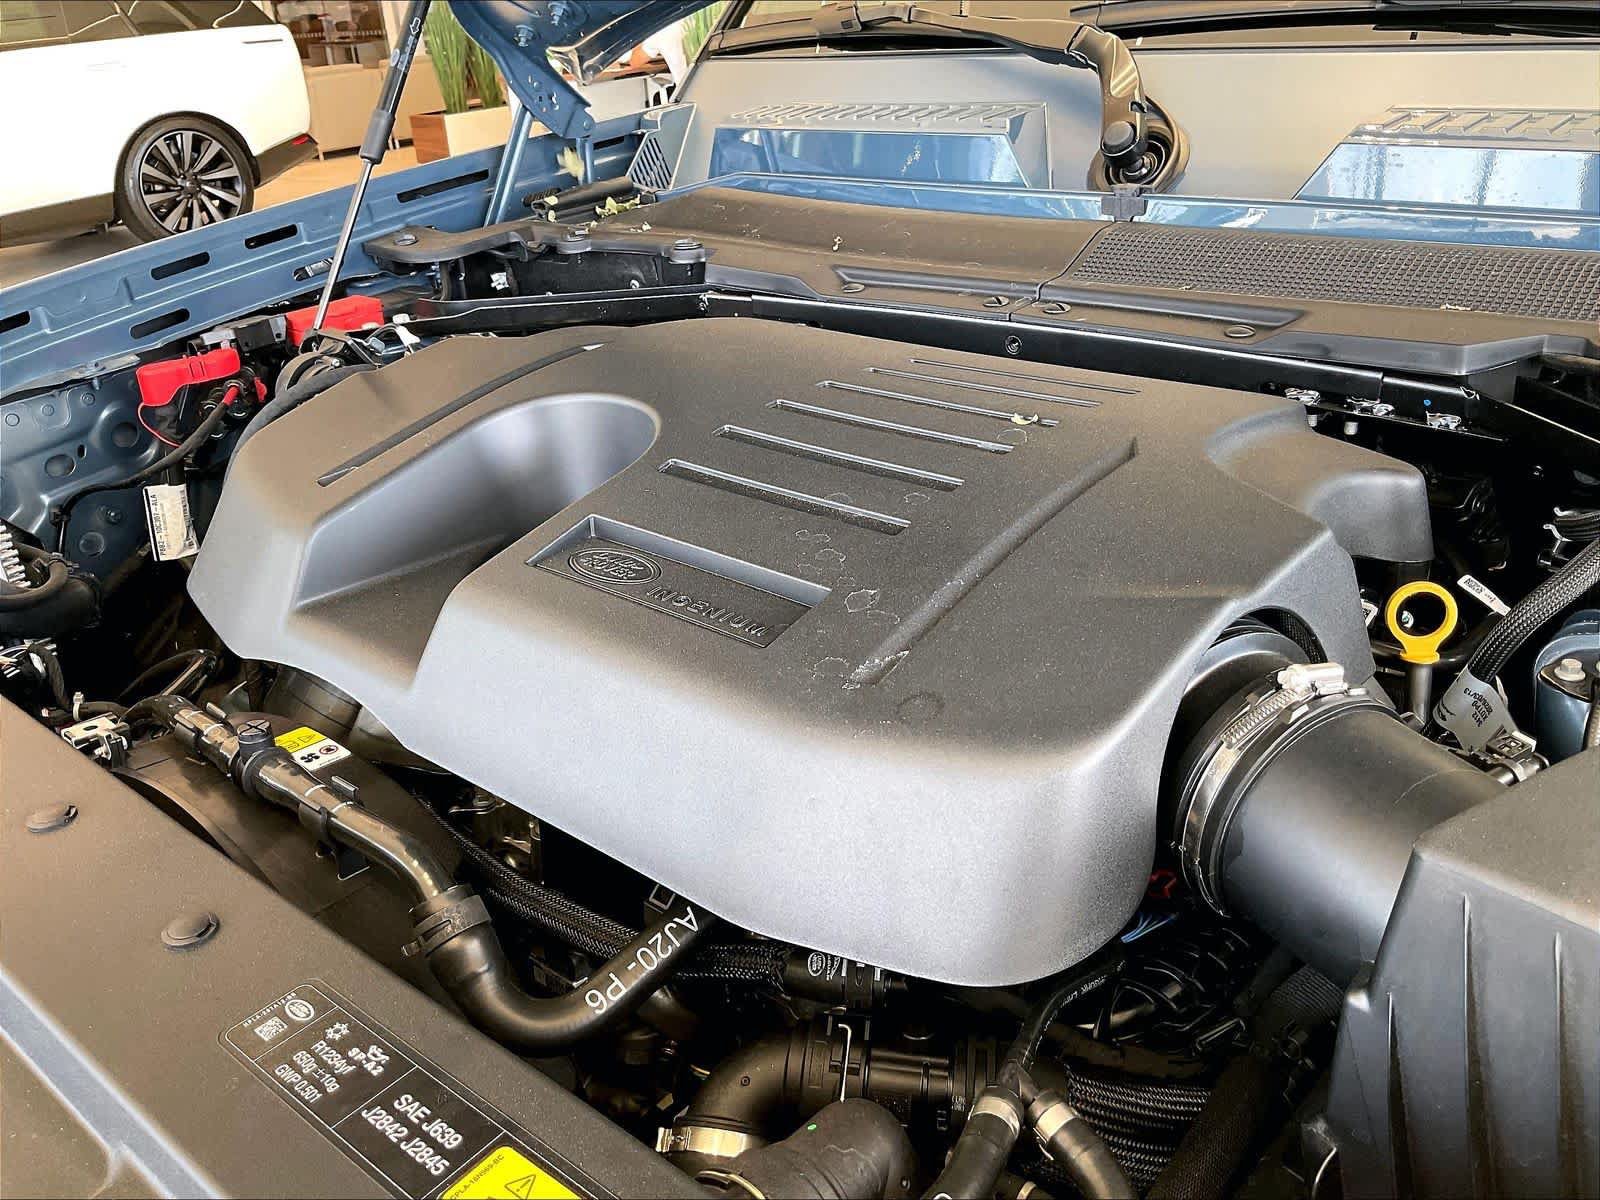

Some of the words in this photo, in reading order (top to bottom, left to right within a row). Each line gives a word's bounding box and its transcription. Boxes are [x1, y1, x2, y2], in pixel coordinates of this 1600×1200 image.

[645, 586, 768, 637] INGENIUM
[292, 1050, 318, 1074] 650g
[312, 1068, 340, 1093] ±10g
[310, 1040, 356, 1075] R1234yf
[274, 1063, 301, 1086] GWP
[295, 1078, 323, 1103] 0.501
[361, 1106, 408, 1143] J2842
[400, 1136, 450, 1176] J2845
[393, 1094, 431, 1124] SAE
[422, 1118, 463, 1150] J639
